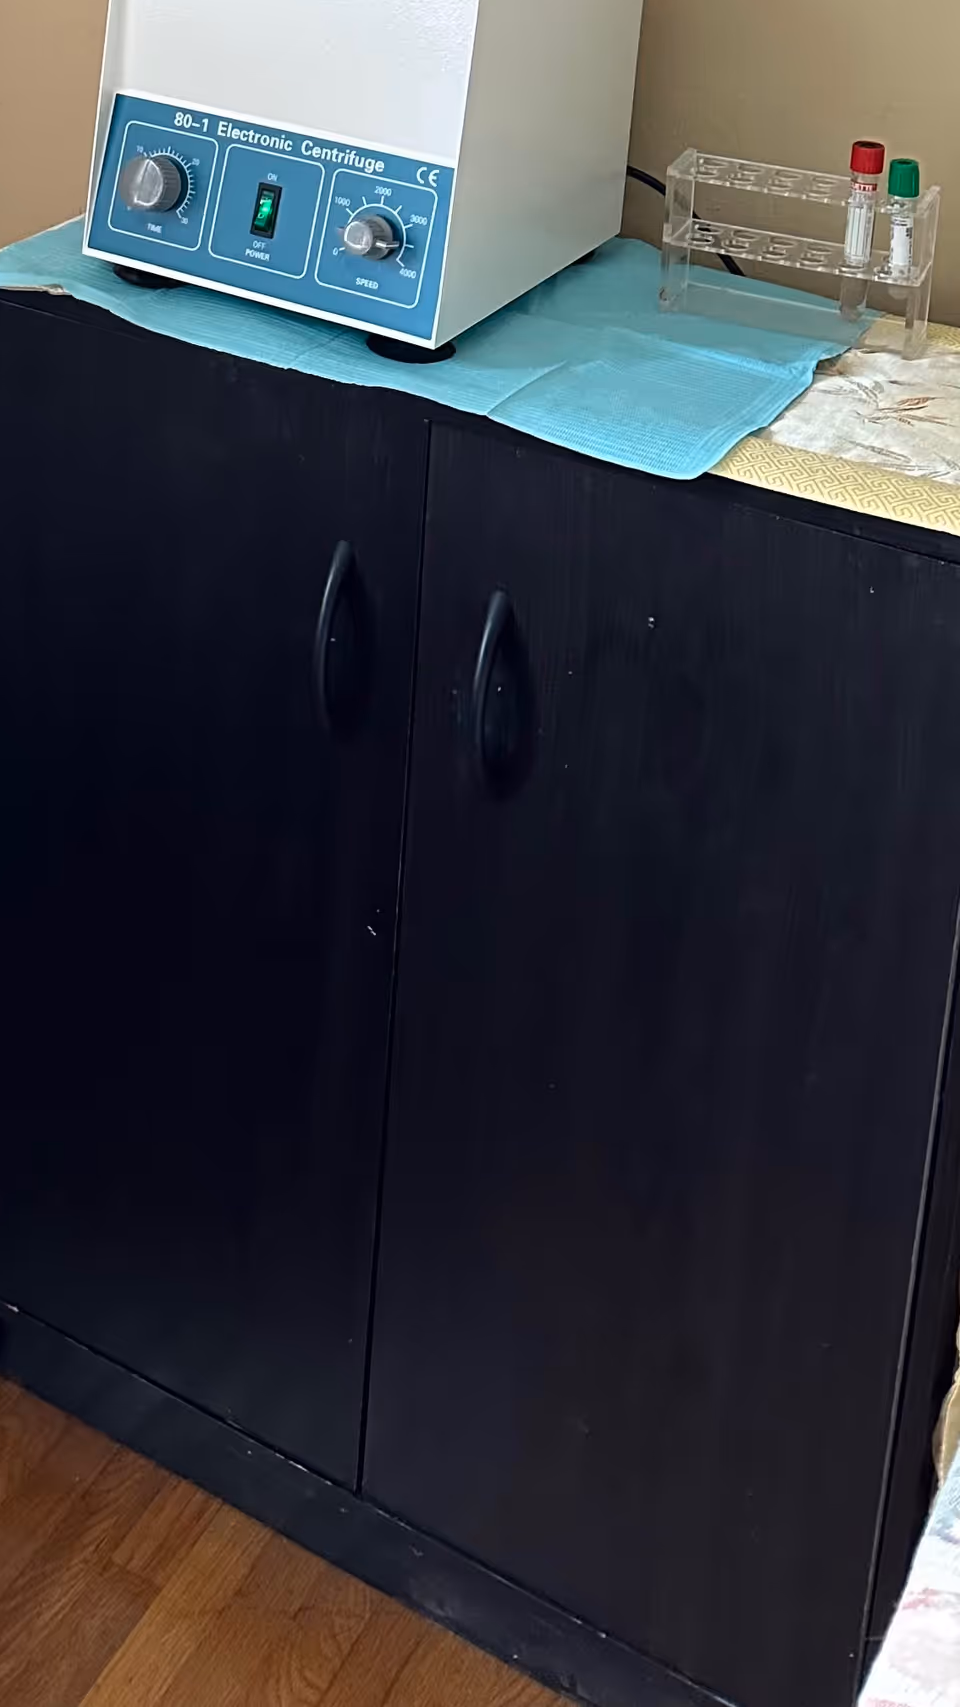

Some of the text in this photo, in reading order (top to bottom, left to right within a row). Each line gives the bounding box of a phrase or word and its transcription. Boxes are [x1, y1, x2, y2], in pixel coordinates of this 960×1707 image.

[173, 111, 385, 173] 80-1 Electronic Centrifuge
[267, 172, 278, 182] ON
[374, 185, 392, 197] 2000
[334, 195, 351, 207] 1000
[409, 214, 428, 226] 3000
[147, 223, 162, 234] TIME
[252, 240, 266, 251] OFF
[245, 248, 271, 262] POWER
[332, 248, 339, 256] 0
[399, 267, 417, 280] 4000
[355, 276, 379, 290] SPEED
